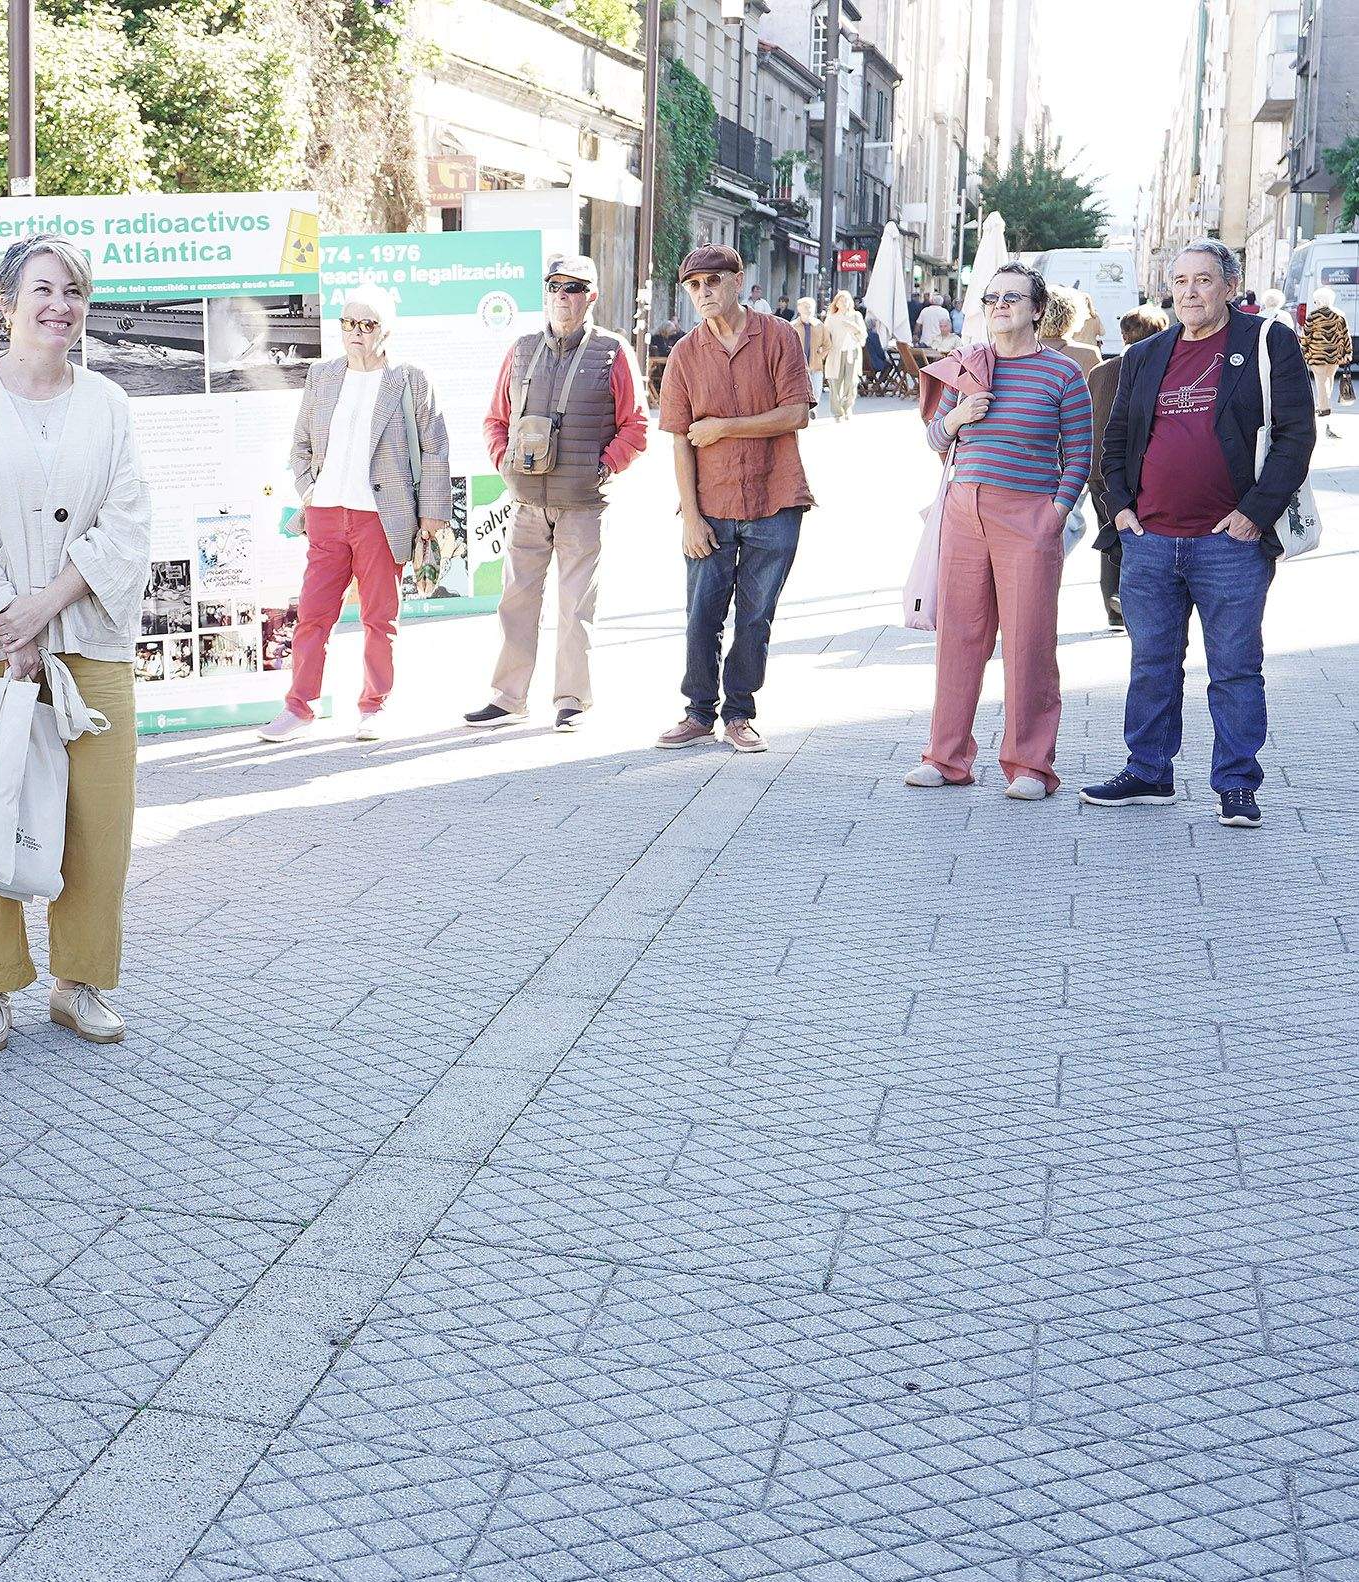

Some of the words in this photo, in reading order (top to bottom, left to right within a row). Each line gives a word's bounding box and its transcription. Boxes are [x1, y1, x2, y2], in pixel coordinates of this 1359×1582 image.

[104, 211, 270, 235] radioactivos
[103, 242, 232, 264] Atlántica
[321, 246, 351, 263] 74
[370, 244, 421, 263] 1976
[321, 266, 389, 284] eación
[392, 269, 407, 283] e
[410, 262, 524, 285] legalización
